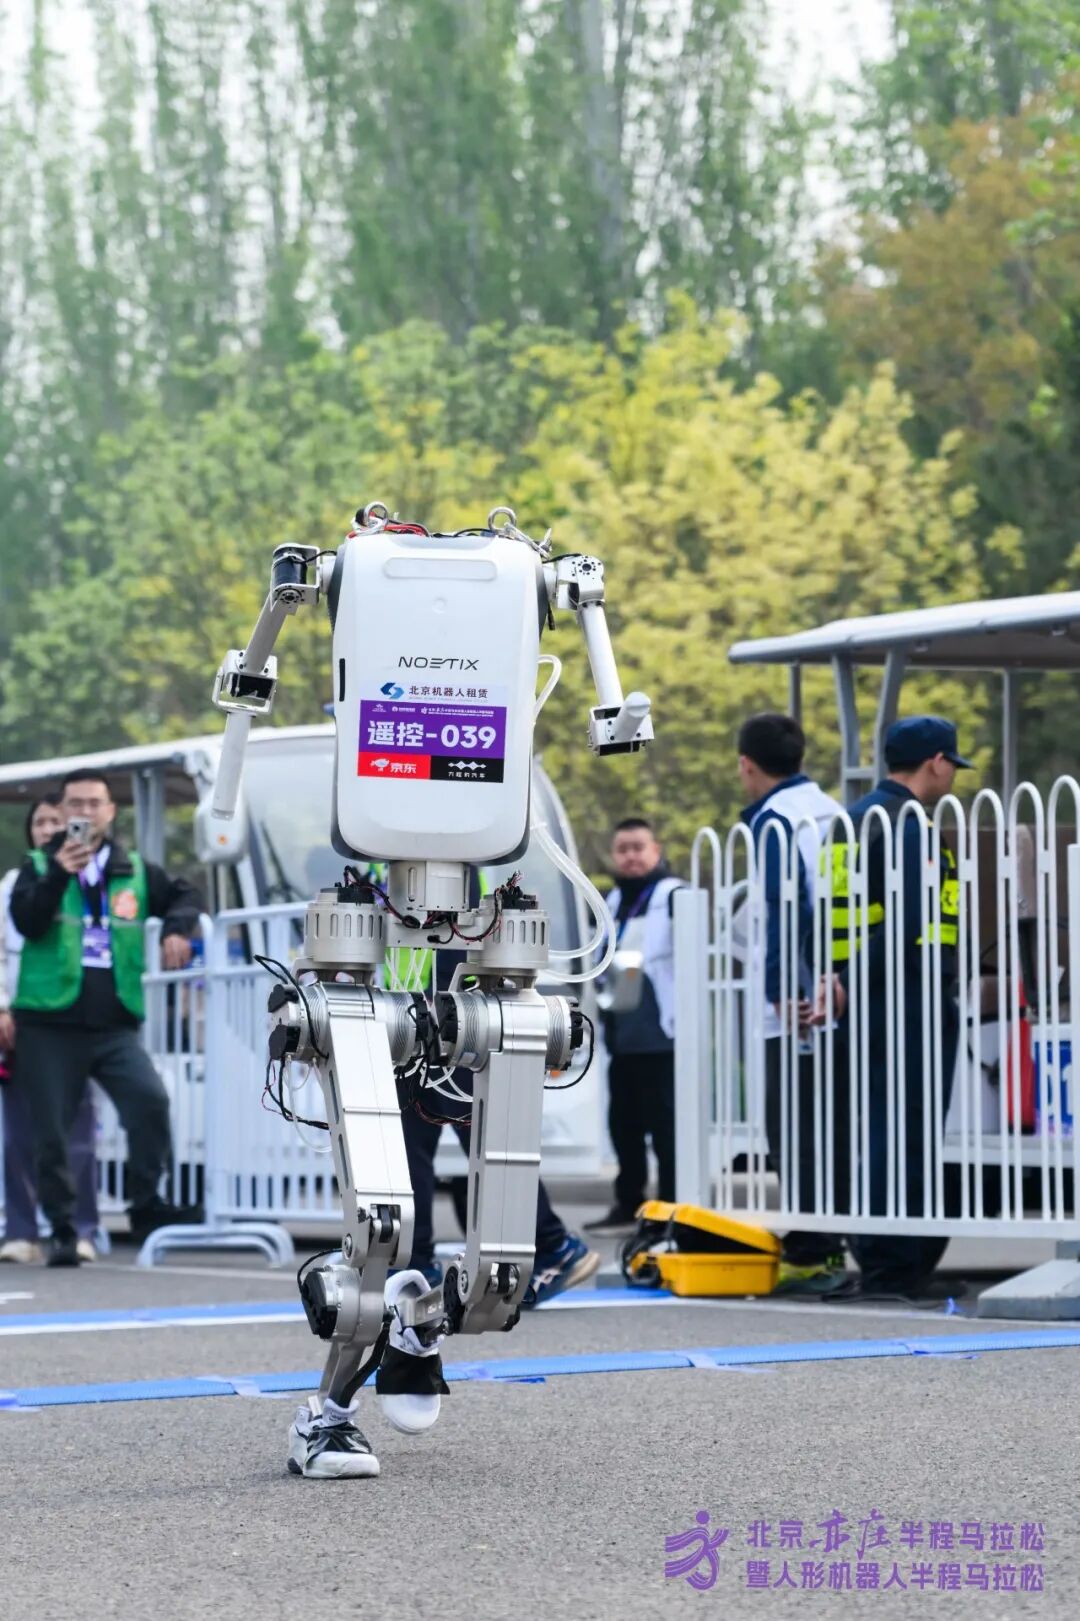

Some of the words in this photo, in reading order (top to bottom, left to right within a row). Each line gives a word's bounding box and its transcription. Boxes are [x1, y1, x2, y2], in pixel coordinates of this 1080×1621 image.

[398, 656, 479, 671] NOETIX
[409, 685, 489, 699] 北京机器人租赁
[367, 720, 497, 749] 遥控-039
[390, 762, 417, 774] 京东
